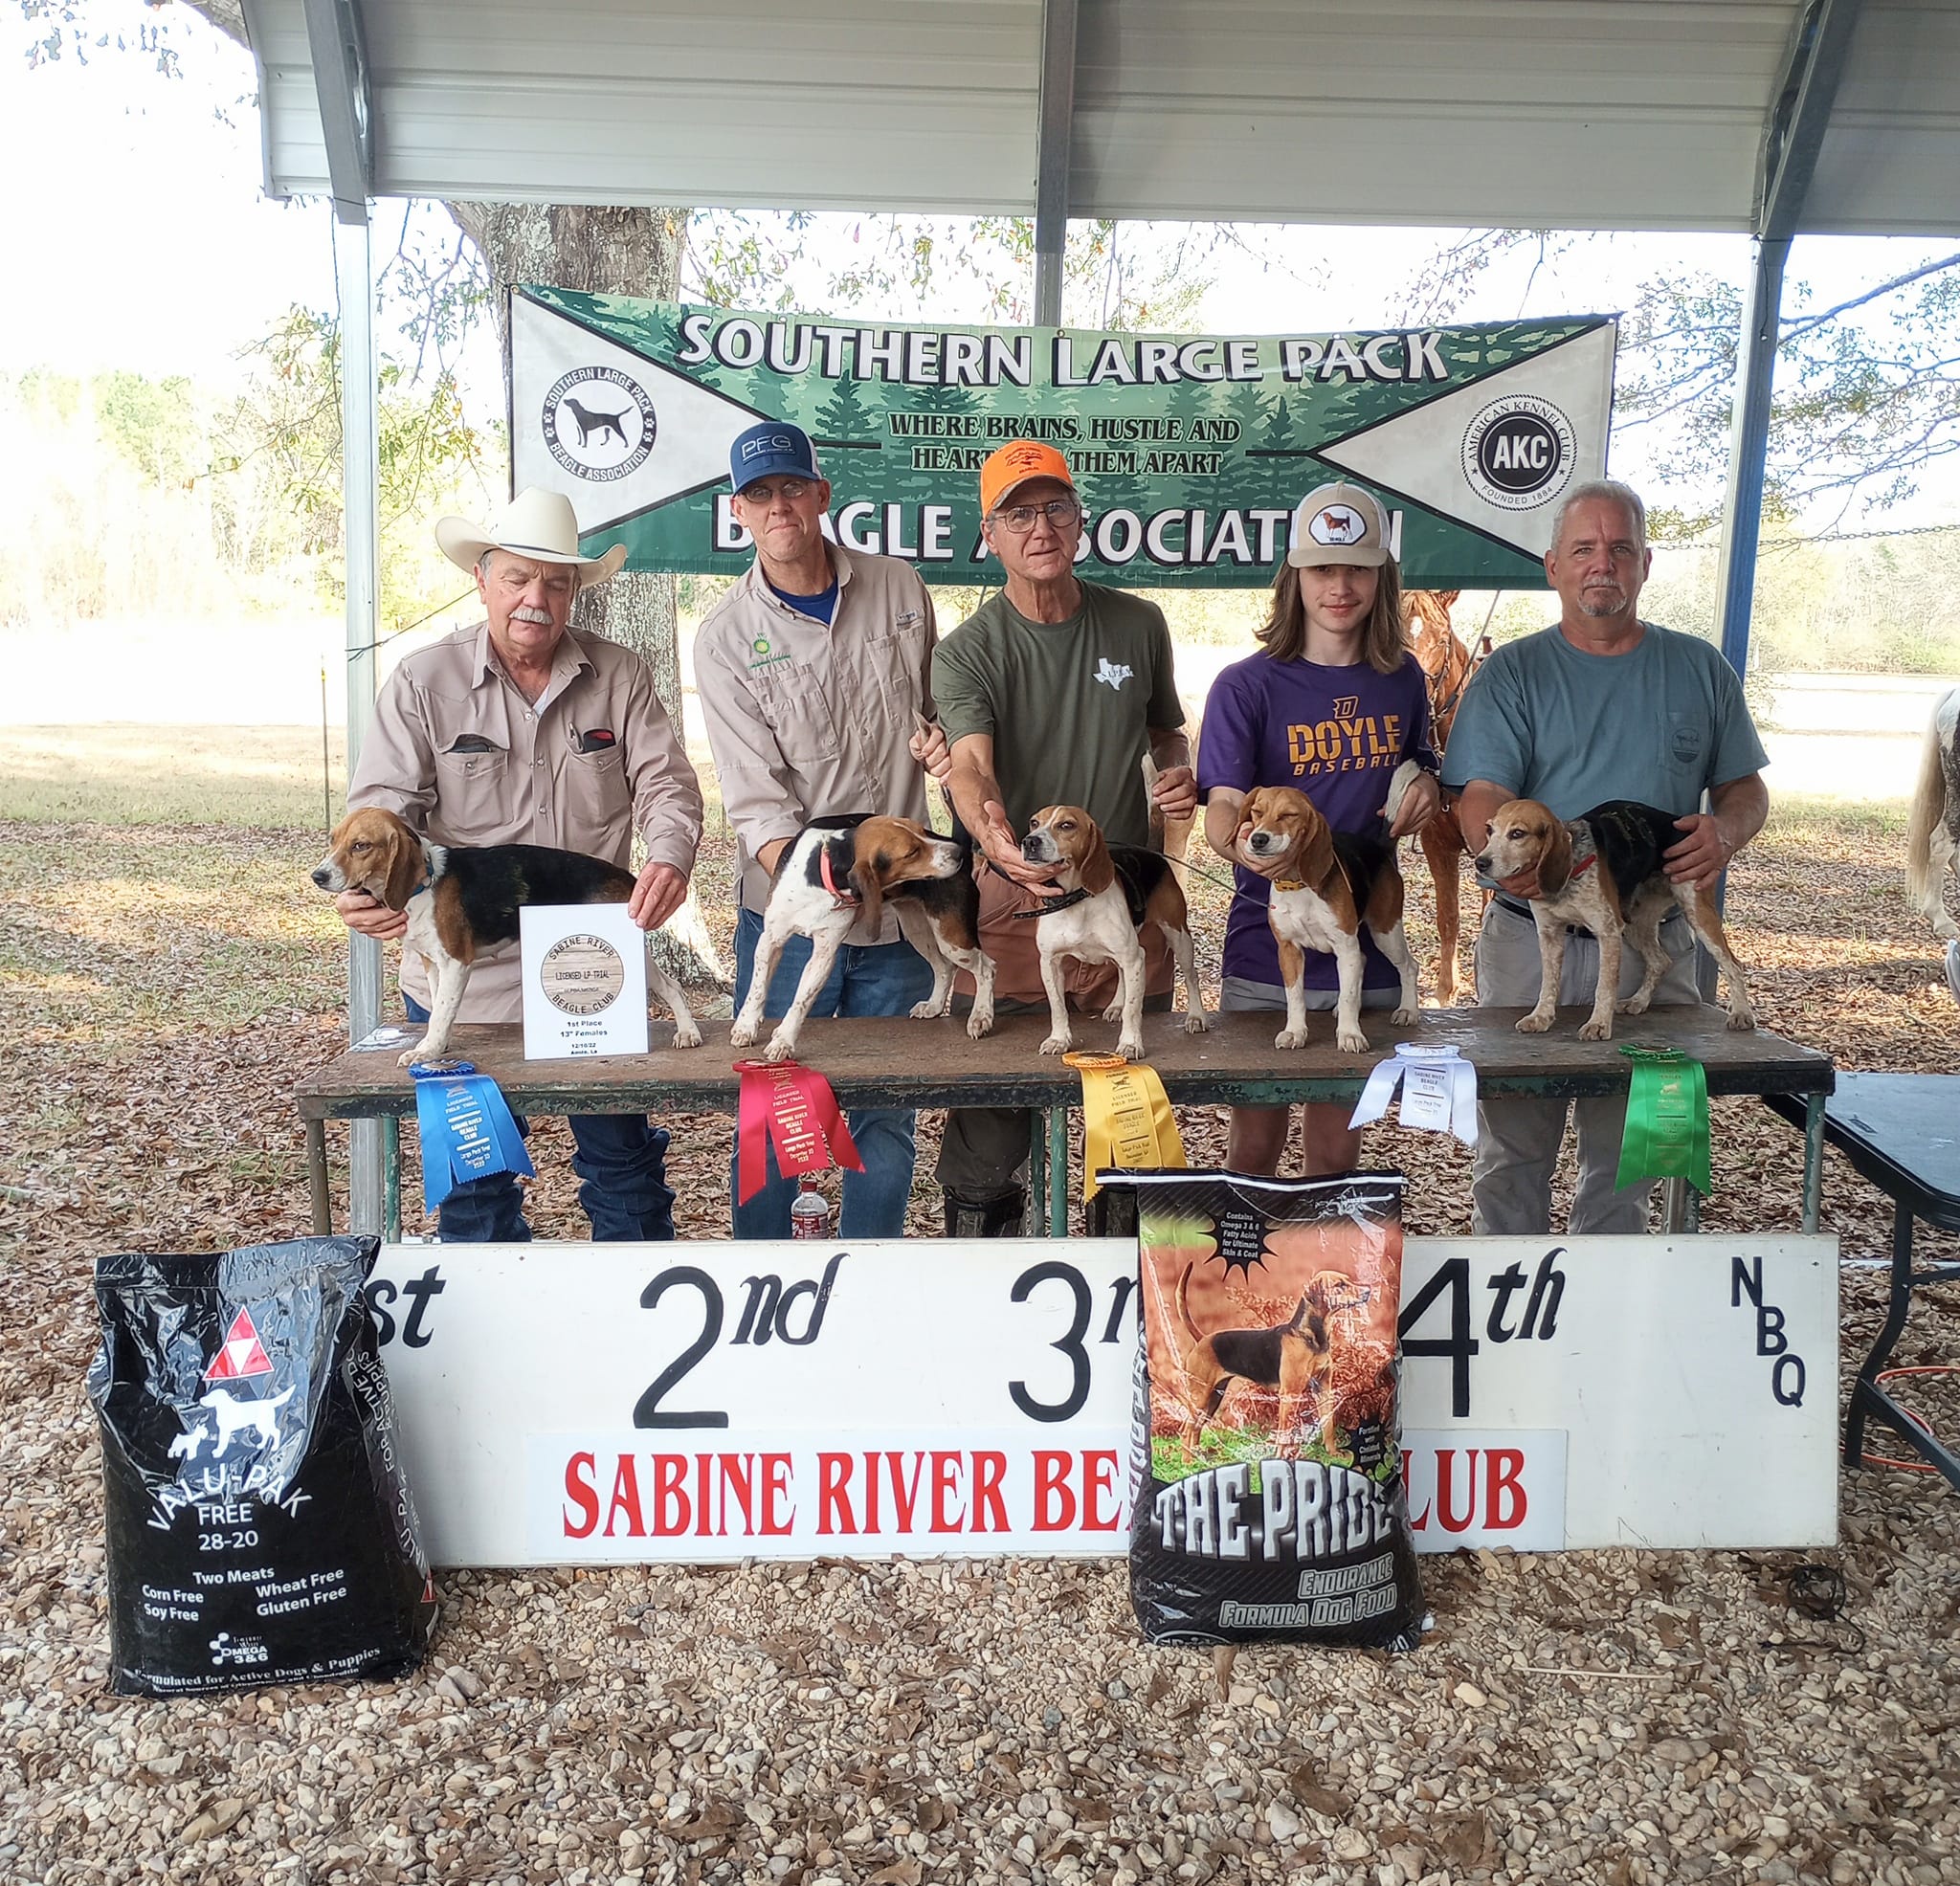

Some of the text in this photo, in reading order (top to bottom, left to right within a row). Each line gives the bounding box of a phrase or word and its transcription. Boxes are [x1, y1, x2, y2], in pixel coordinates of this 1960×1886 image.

[676, 313, 1450, 387] SOUTHERN LARGE PACK
[546, 367, 655, 415] SOUTHERN LARGE PACK
[888, 412, 1241, 442] WHERE BRAINS, HUSTLE AND
[1468, 401, 1570, 462] AMERICAN KENNEL CLUB
[549, 442, 650, 482] BEAGLE ASSOCIATION
[741, 434, 791, 458] PFG
[1069, 451, 1138, 475] THEM
[1142, 453, 1221, 475] APART
[1492, 435, 1548, 469] AKC
[1481, 484, 1553, 505] FOUNDED 1884
[712, 493, 955, 562] BGLE
[1287, 715, 1401, 765] DOYLE
[1293, 754, 1398, 776] BASEBALL
[549, 936, 615, 961] SABINE RIVER
[551, 991, 615, 1014] BEAGLE CLUB
[364, 1263, 447, 1349] st
[633, 1253, 851, 1430] 2nd
[1008, 1260, 1140, 1423] 3r
[1398, 1246, 1569, 1418] 4th
[353, 1375, 385, 1431] ACTIVE
[380, 1434, 394, 1473] FOR
[146, 1463, 314, 1532] VALU-PAK
[563, 1451, 795, 1539] SABINE
[814, 1449, 1009, 1535] RIVER
[1401, 1448, 1527, 1533] LUB
[1155, 1458, 1392, 1563] THE PRIDE
[197, 1503, 254, 1526] FREE
[197, 1529, 259, 1551] 28-20
[192, 1566, 275, 1585] Two Meats
[255, 1567, 345, 1598] Wheat Free
[1299, 1552, 1393, 1599] ENDURANCE
[142, 1584, 205, 1604] Corn Free
[256, 1586, 347, 1617] Gluten Free
[1219, 1582, 1398, 1628] FORMULA DOG FOOD
[143, 1603, 199, 1622] Soy Free
[204, 1675, 225, 1685] for
[230, 1670, 271, 1683] Active
[274, 1667, 308, 1678] Dogs
[311, 1662, 324, 1675] &
[328, 1647, 382, 1671] Puppies
[221, 1645, 268, 1657] OMEGA
